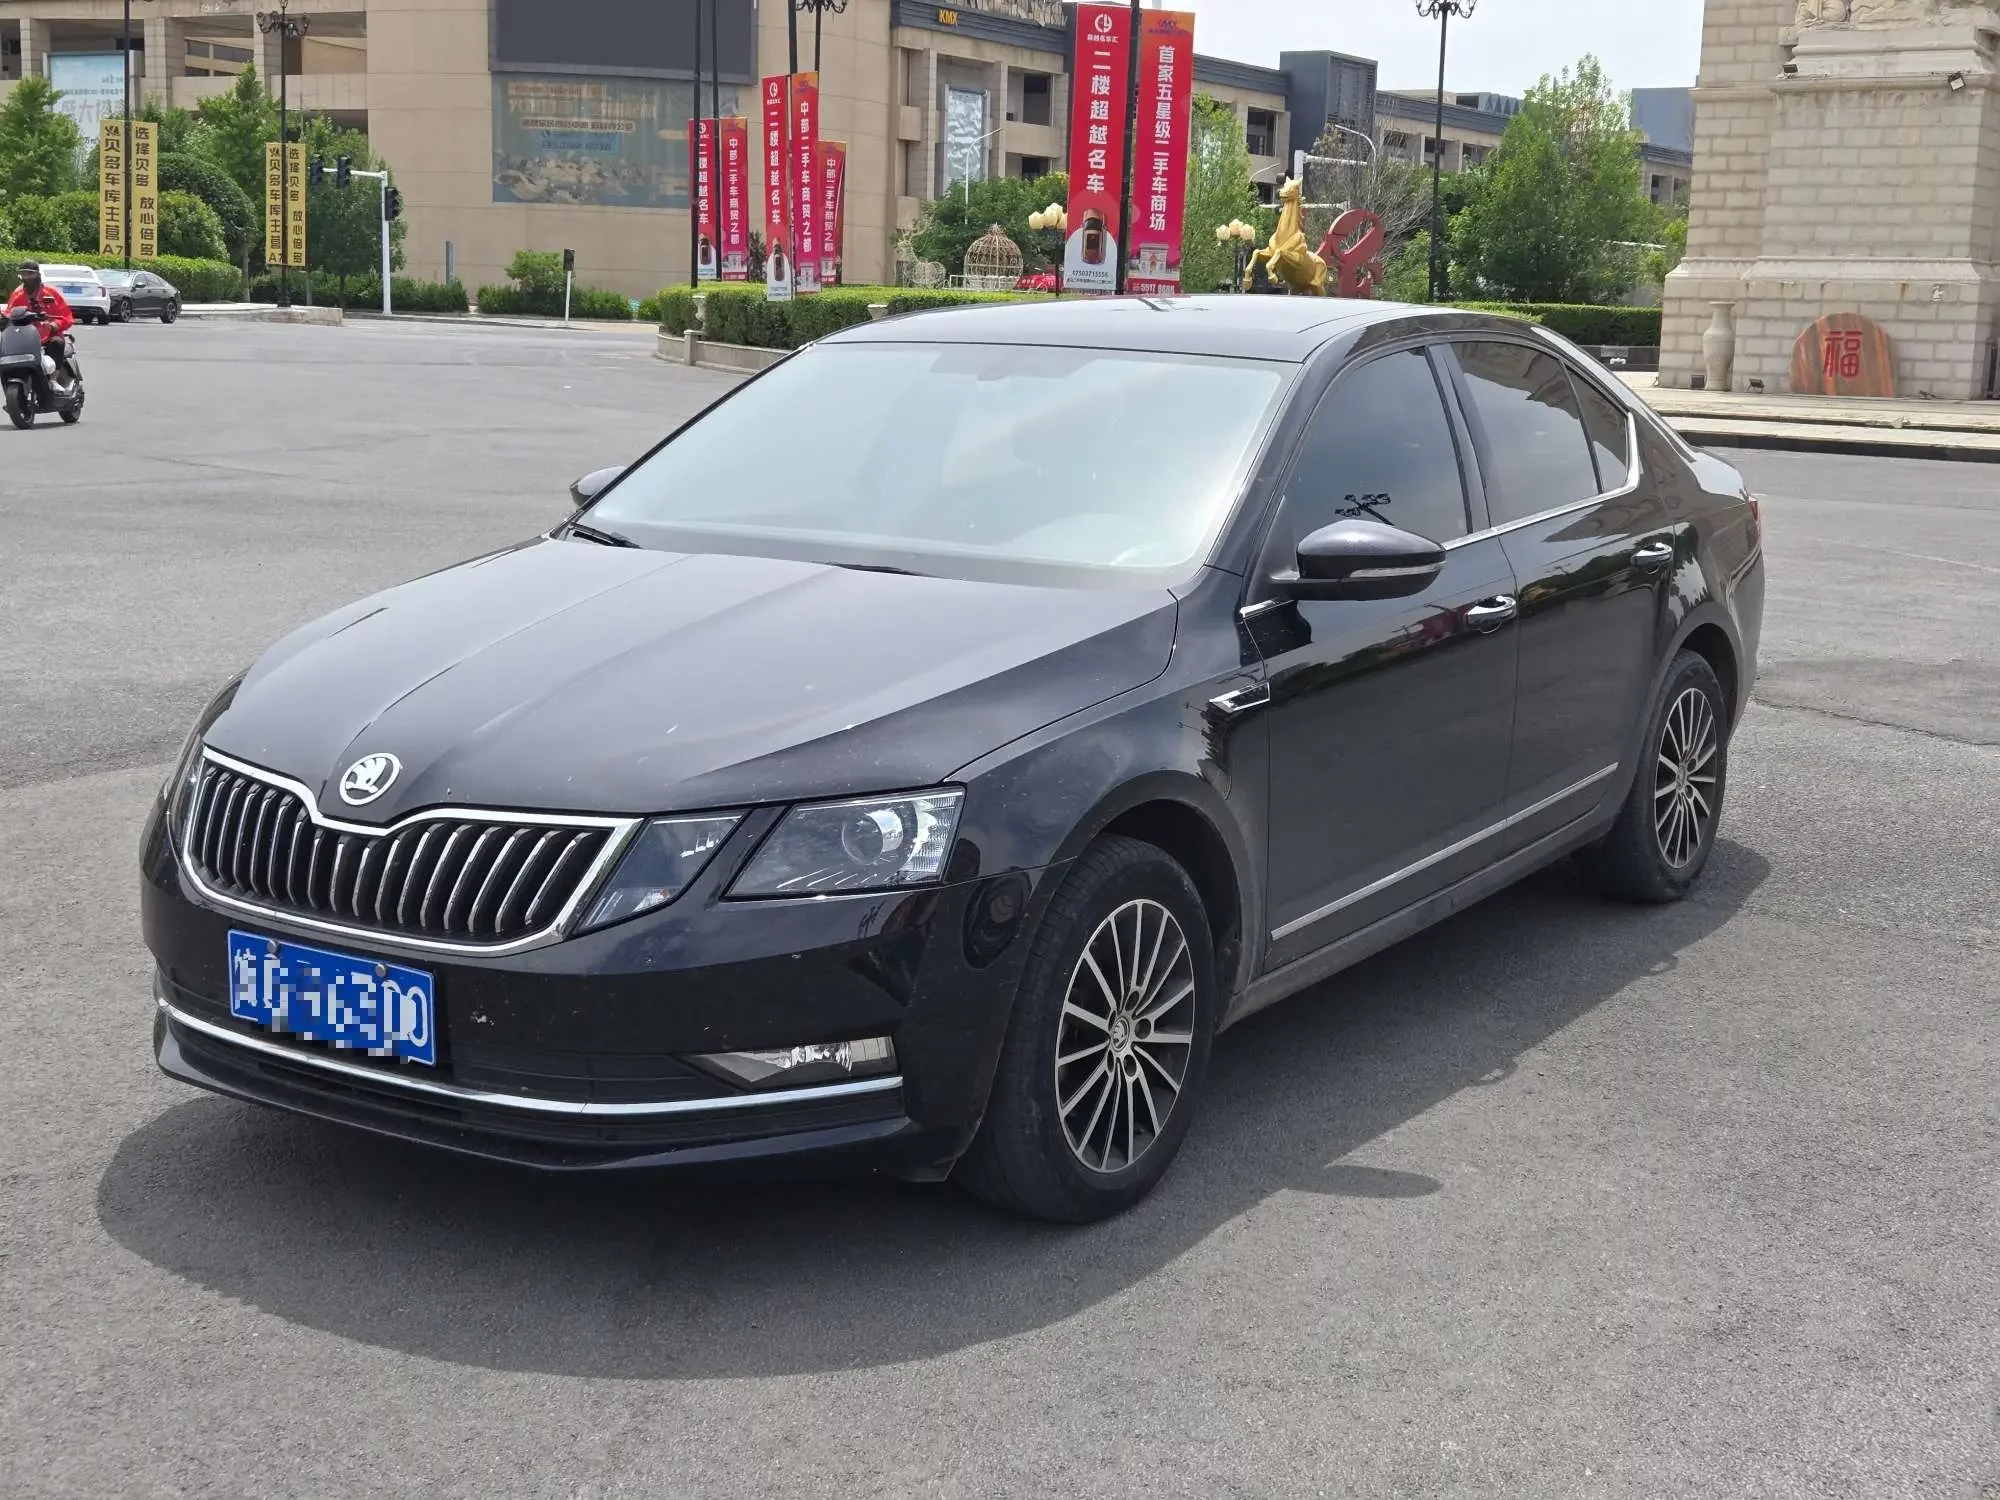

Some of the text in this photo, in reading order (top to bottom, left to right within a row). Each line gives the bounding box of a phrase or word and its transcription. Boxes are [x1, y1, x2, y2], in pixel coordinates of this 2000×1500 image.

[135, 126, 150, 187] 选择贝多
[770, 111, 781, 225] 二楼超越名车
[1086, 50, 1112, 194] 二楼超越名车
[1149, 45, 1176, 232] 首家五星级二手车商场
[1823, 330, 1863, 378] 福
